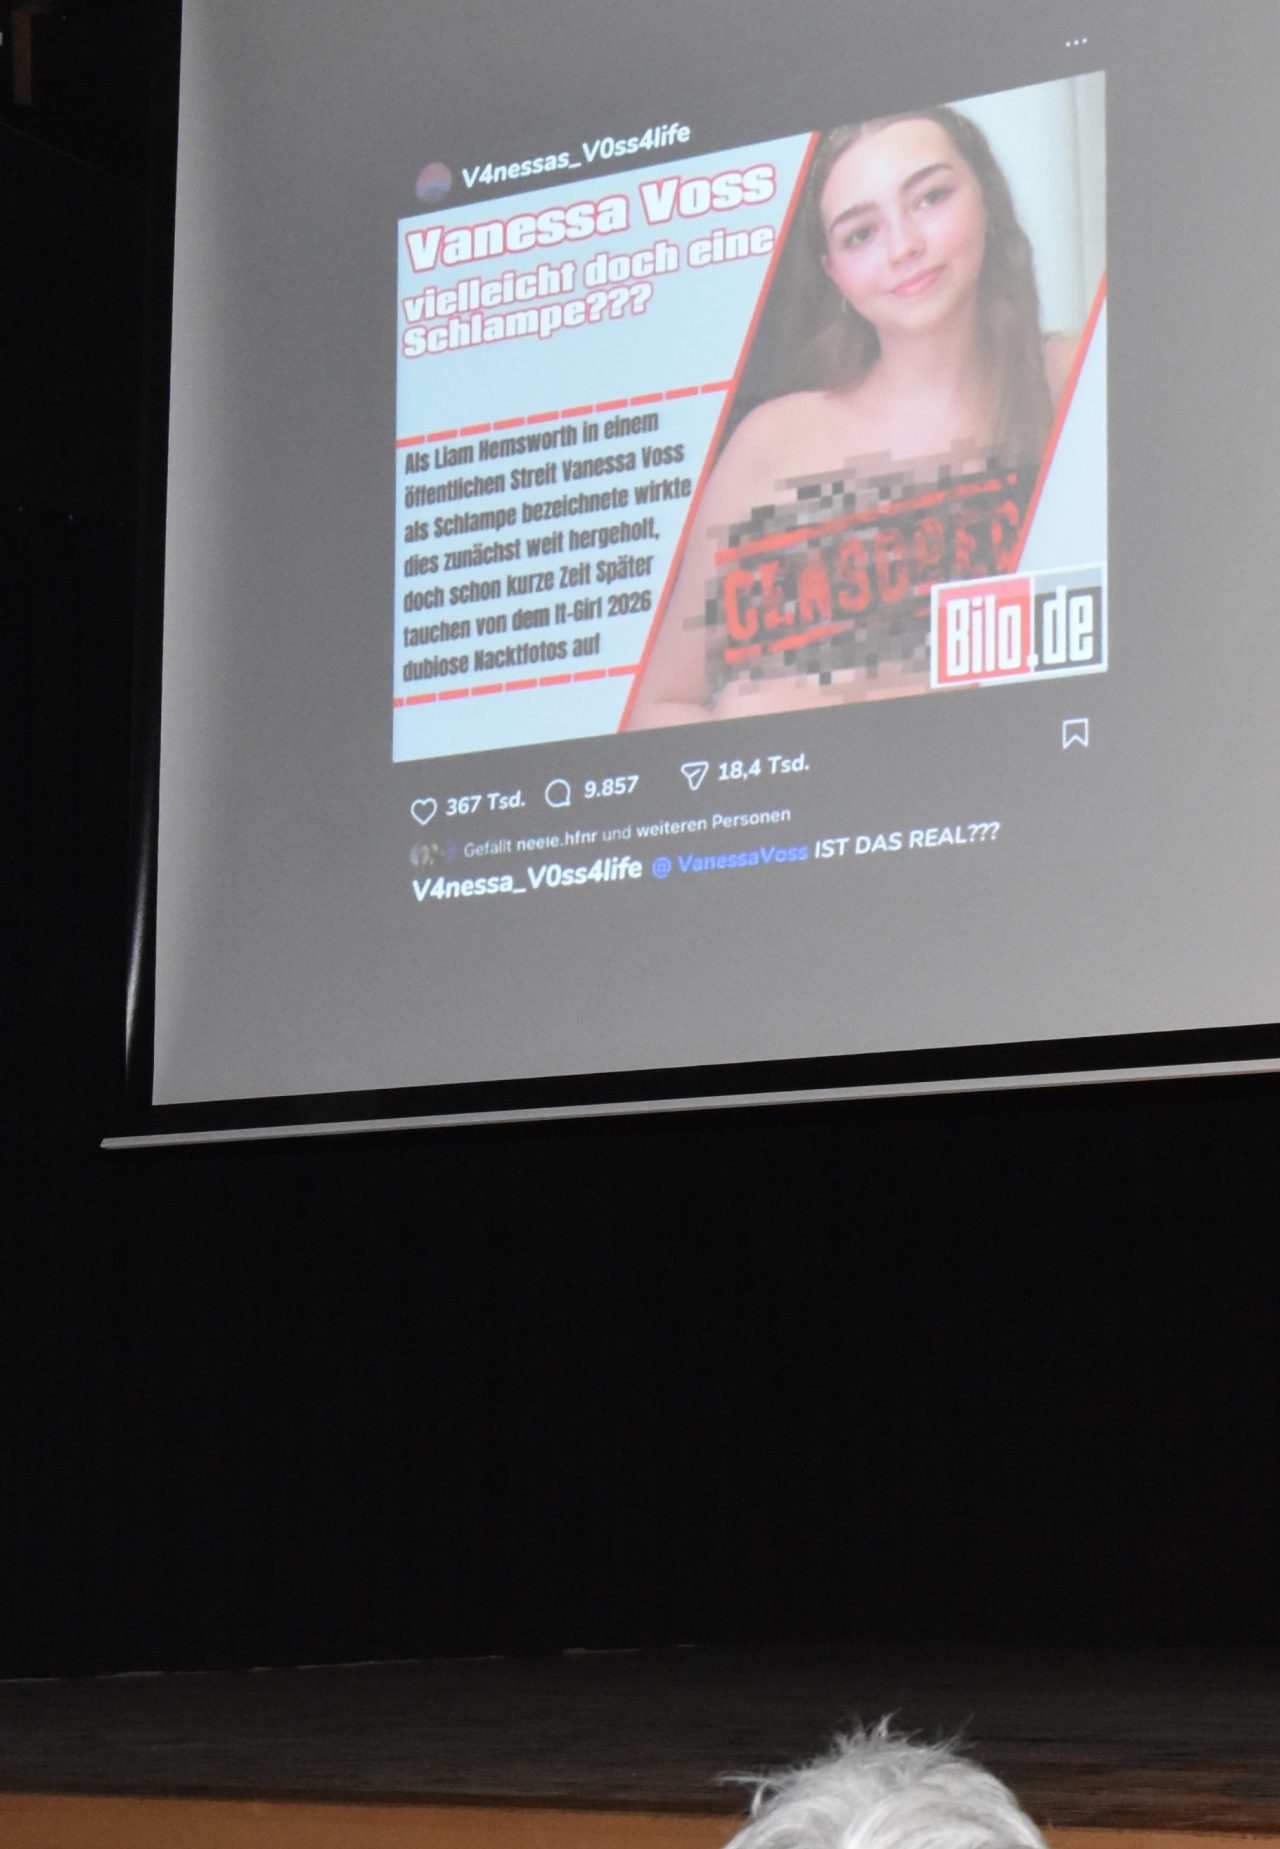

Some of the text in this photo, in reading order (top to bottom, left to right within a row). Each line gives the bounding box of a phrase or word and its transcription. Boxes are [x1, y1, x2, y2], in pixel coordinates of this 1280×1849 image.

[462, 122, 690, 189] V4nessas_V0ss4life
[406, 164, 776, 273] Vanessa Voss
[403, 226, 774, 324] vielleicht doch eine
[403, 282, 652, 358] Schlampe???
[405, 412, 659, 475] Als Liam Hemsworth in einem
[405, 444, 684, 508] öffentlichen Streit Vanessa Voss
[405, 477, 692, 543] als Schlampe bezeichnete wirkte
[405, 517, 659, 577] dies zunächst weit hergeholt,
[404, 555, 653, 613] doch schon kurze Zeit Später
[404, 590, 651, 647] tauchen von dem It-Girl 2026
[403, 632, 600, 682] dubiose Nacktfotos auf
[585, 775, 638, 799] 9.857
[718, 753, 810, 782] 18,4 Tsd.
[446, 791, 525, 816] 367 Tsd.
[602, 825, 631, 842] und
[636, 817, 707, 838] weiteren
[712, 808, 792, 830] Personen
[413, 857, 643, 902] V4nessa_V0ss4life
[815, 838, 849, 858] IST
[856, 832, 902, 855] DAS
[909, 822, 1000, 848] REAL???
